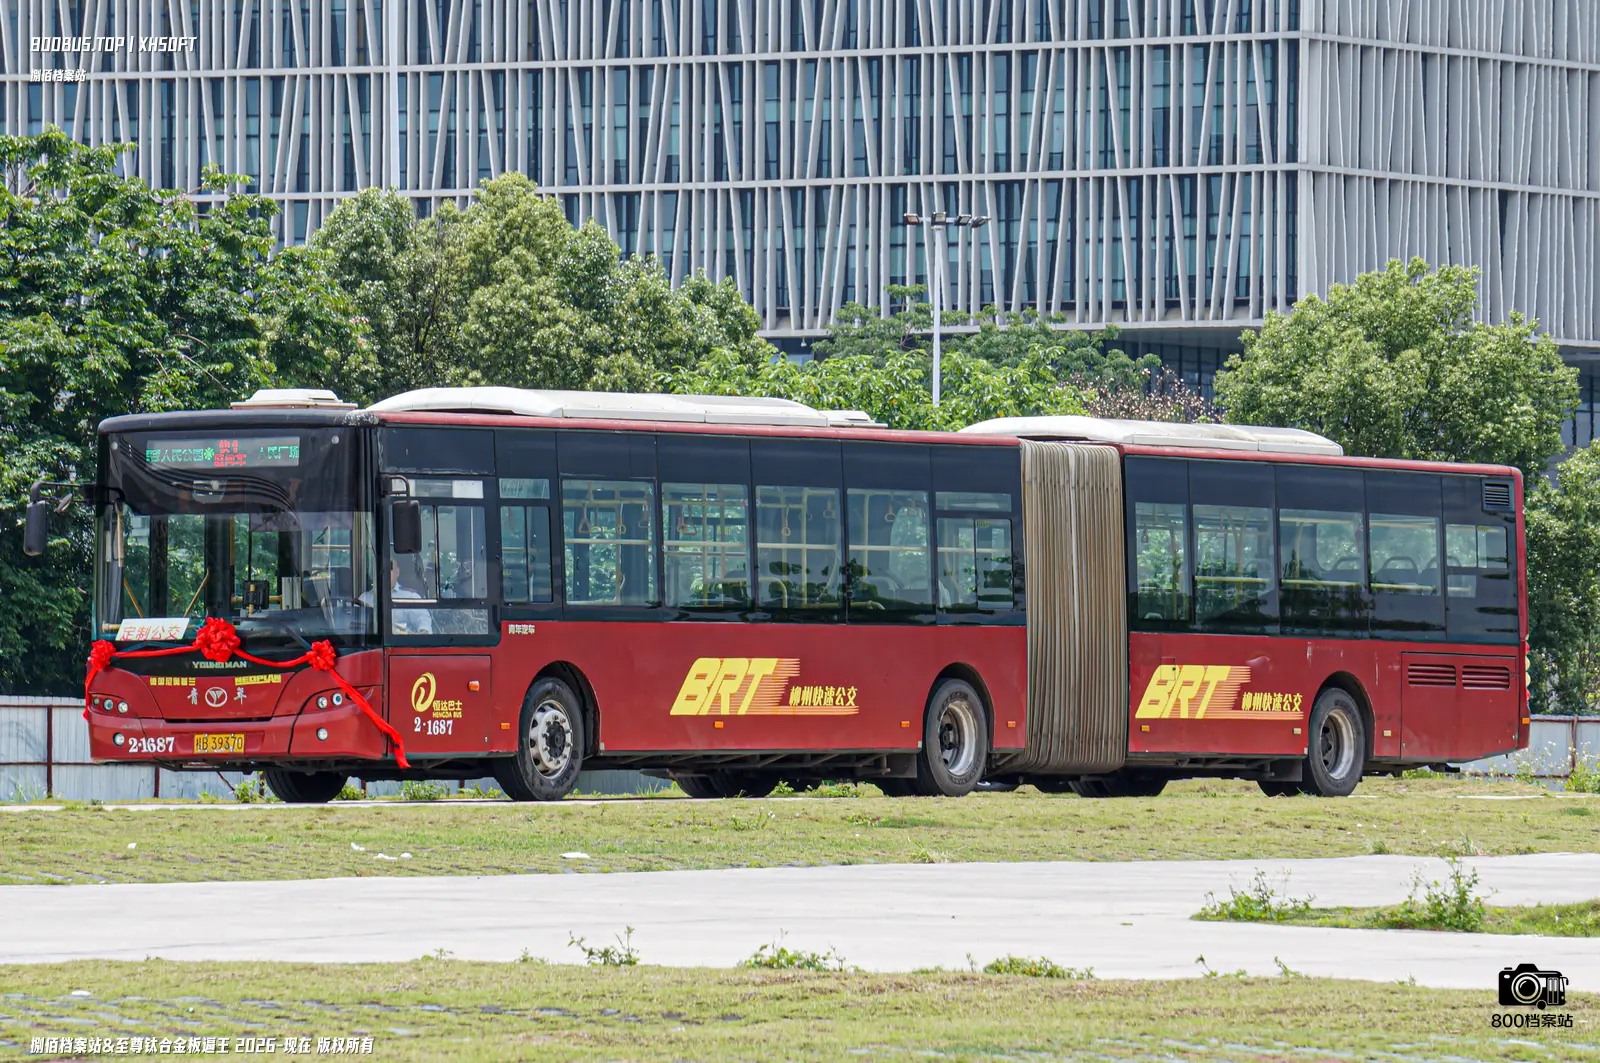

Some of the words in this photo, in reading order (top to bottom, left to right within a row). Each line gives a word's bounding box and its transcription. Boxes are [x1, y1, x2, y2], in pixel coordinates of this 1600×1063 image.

[120, 625, 181, 641] 定制公交
[234, 674, 282, 686] NEOPLAN
[670, 657, 779, 715] BRT
[789, 686, 858, 706] 柳州快速公交
[1135, 664, 1232, 719] BRT
[1242, 691, 1303, 712] 柳州快速公交
[432, 700, 462, 711] 恒达巴士
